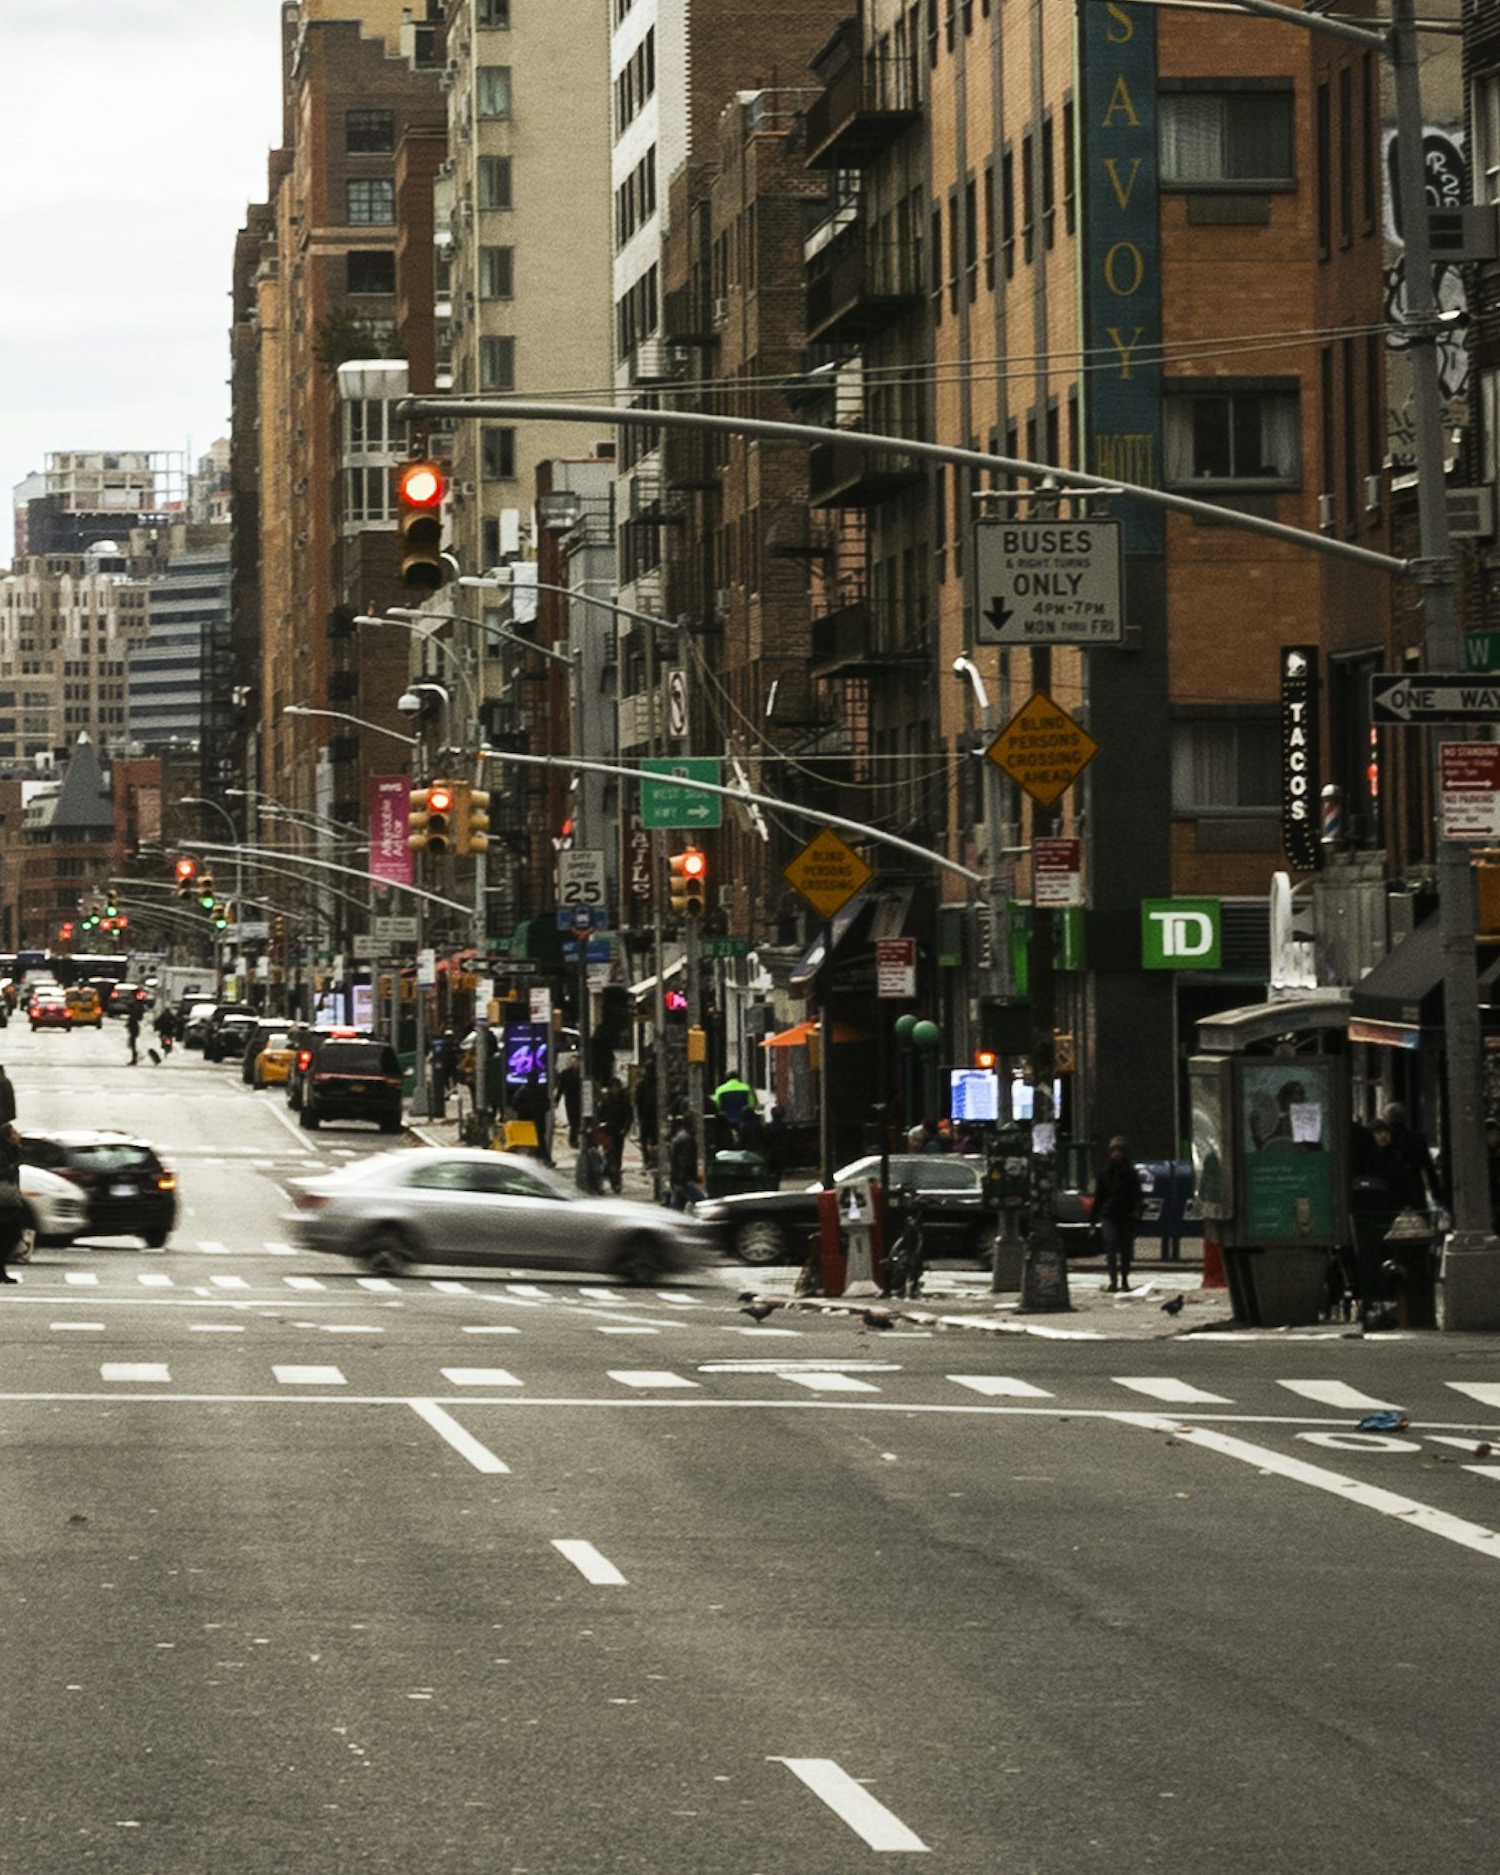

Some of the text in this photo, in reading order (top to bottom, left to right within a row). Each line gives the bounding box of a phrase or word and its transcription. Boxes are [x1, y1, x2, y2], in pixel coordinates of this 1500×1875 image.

[1003, 530, 1092, 554] BUSES
[1017, 558, 1049, 568] RIGHT
[1054, 558, 1092, 568] TURNS
[1013, 573, 1084, 596] ONLY
[1032, 601, 1105, 616] 4PM-7PM
[1024, 619, 1114, 634] MON THRU FRI
[1467, 637, 1489, 666] W
[1391, 689, 1436, 708] ONE
[1020, 717, 1064, 731] BLIND
[1008, 733, 1080, 749] PERSONS
[1007, 751, 1082, 767] CROSSING
[1459, 747, 1499, 757] STANDING
[1289, 701, 1306, 821] TACOS
[1024, 770, 1073, 784] AHEAD
[811, 851, 846, 861] BLIND
[567, 862, 596, 870] SPEED
[804, 864, 853, 876] PERSONS
[564, 881, 601, 903] 25
[800, 879, 854, 891] CROSSING
[1148, 911, 1213, 956] TD
